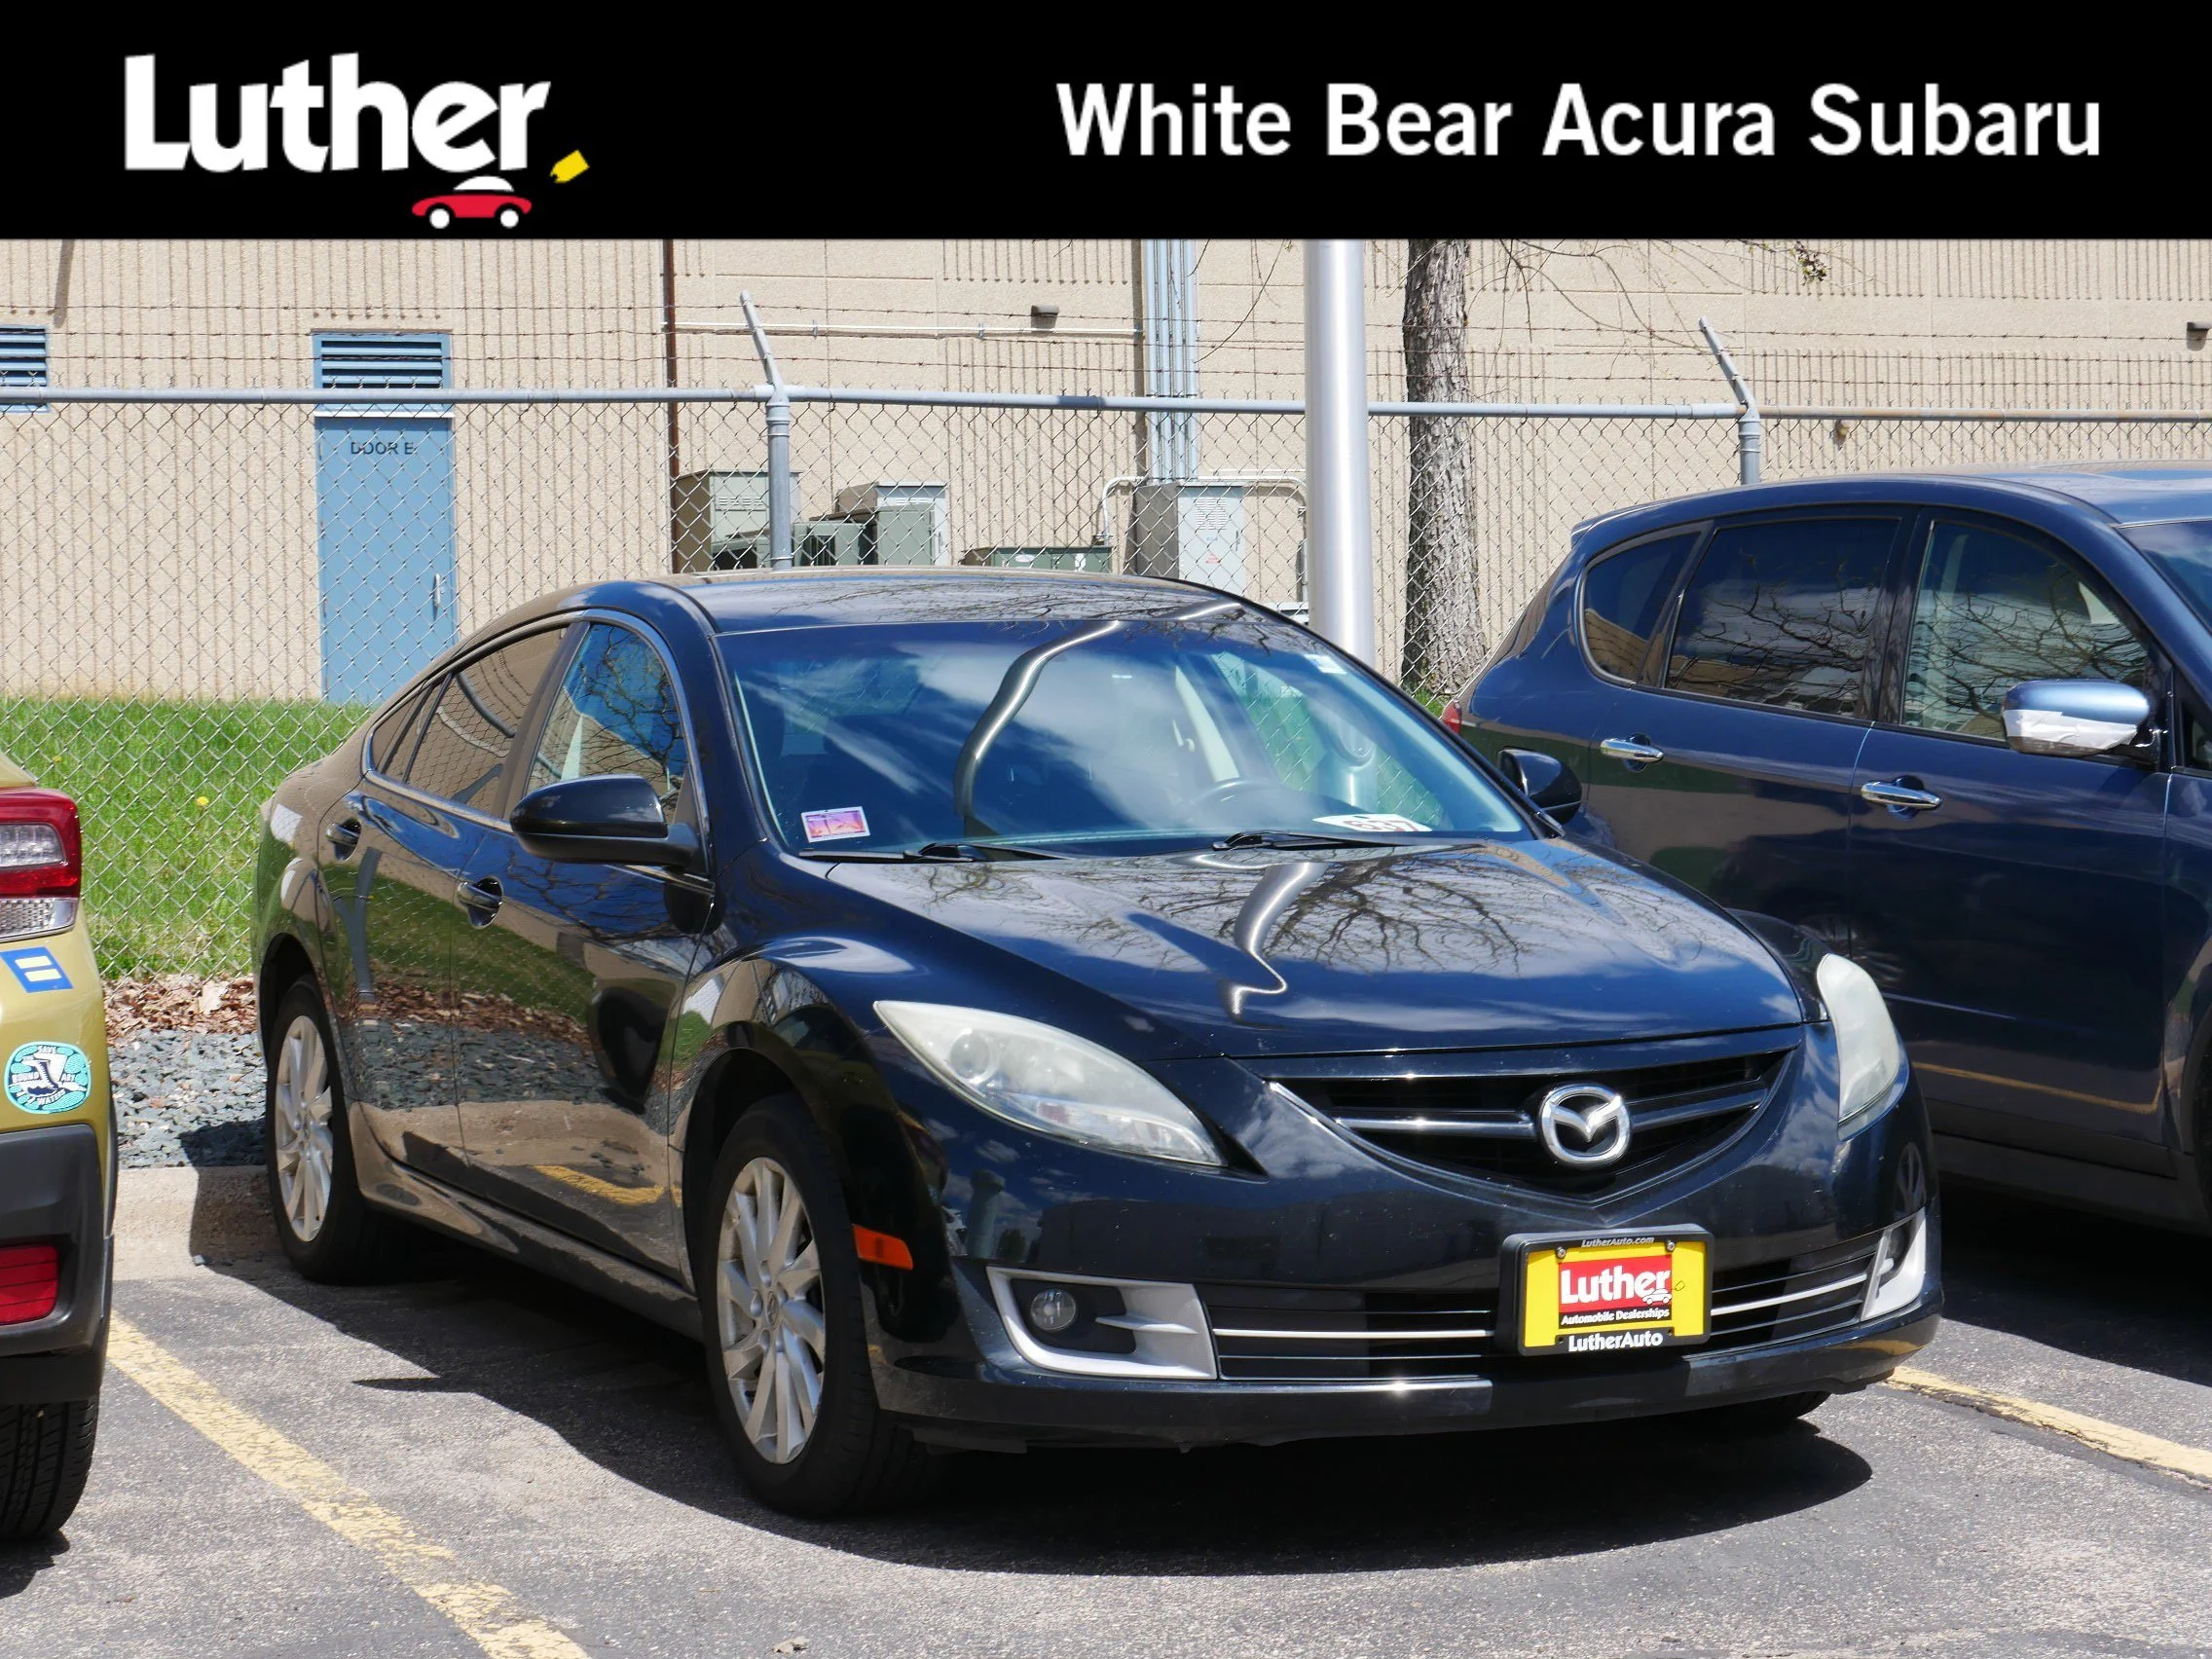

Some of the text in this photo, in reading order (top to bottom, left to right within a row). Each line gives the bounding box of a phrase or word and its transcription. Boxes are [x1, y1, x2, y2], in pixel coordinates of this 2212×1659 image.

[350, 441, 415, 455] DOOR E
[1581, 1236, 1655, 1248] LutherAuto.com
[1561, 1265, 1672, 1304] Luther
[1561, 1308, 1671, 1325] Automobile Dealerships
[1568, 1331, 1664, 1352] LutherAuto
